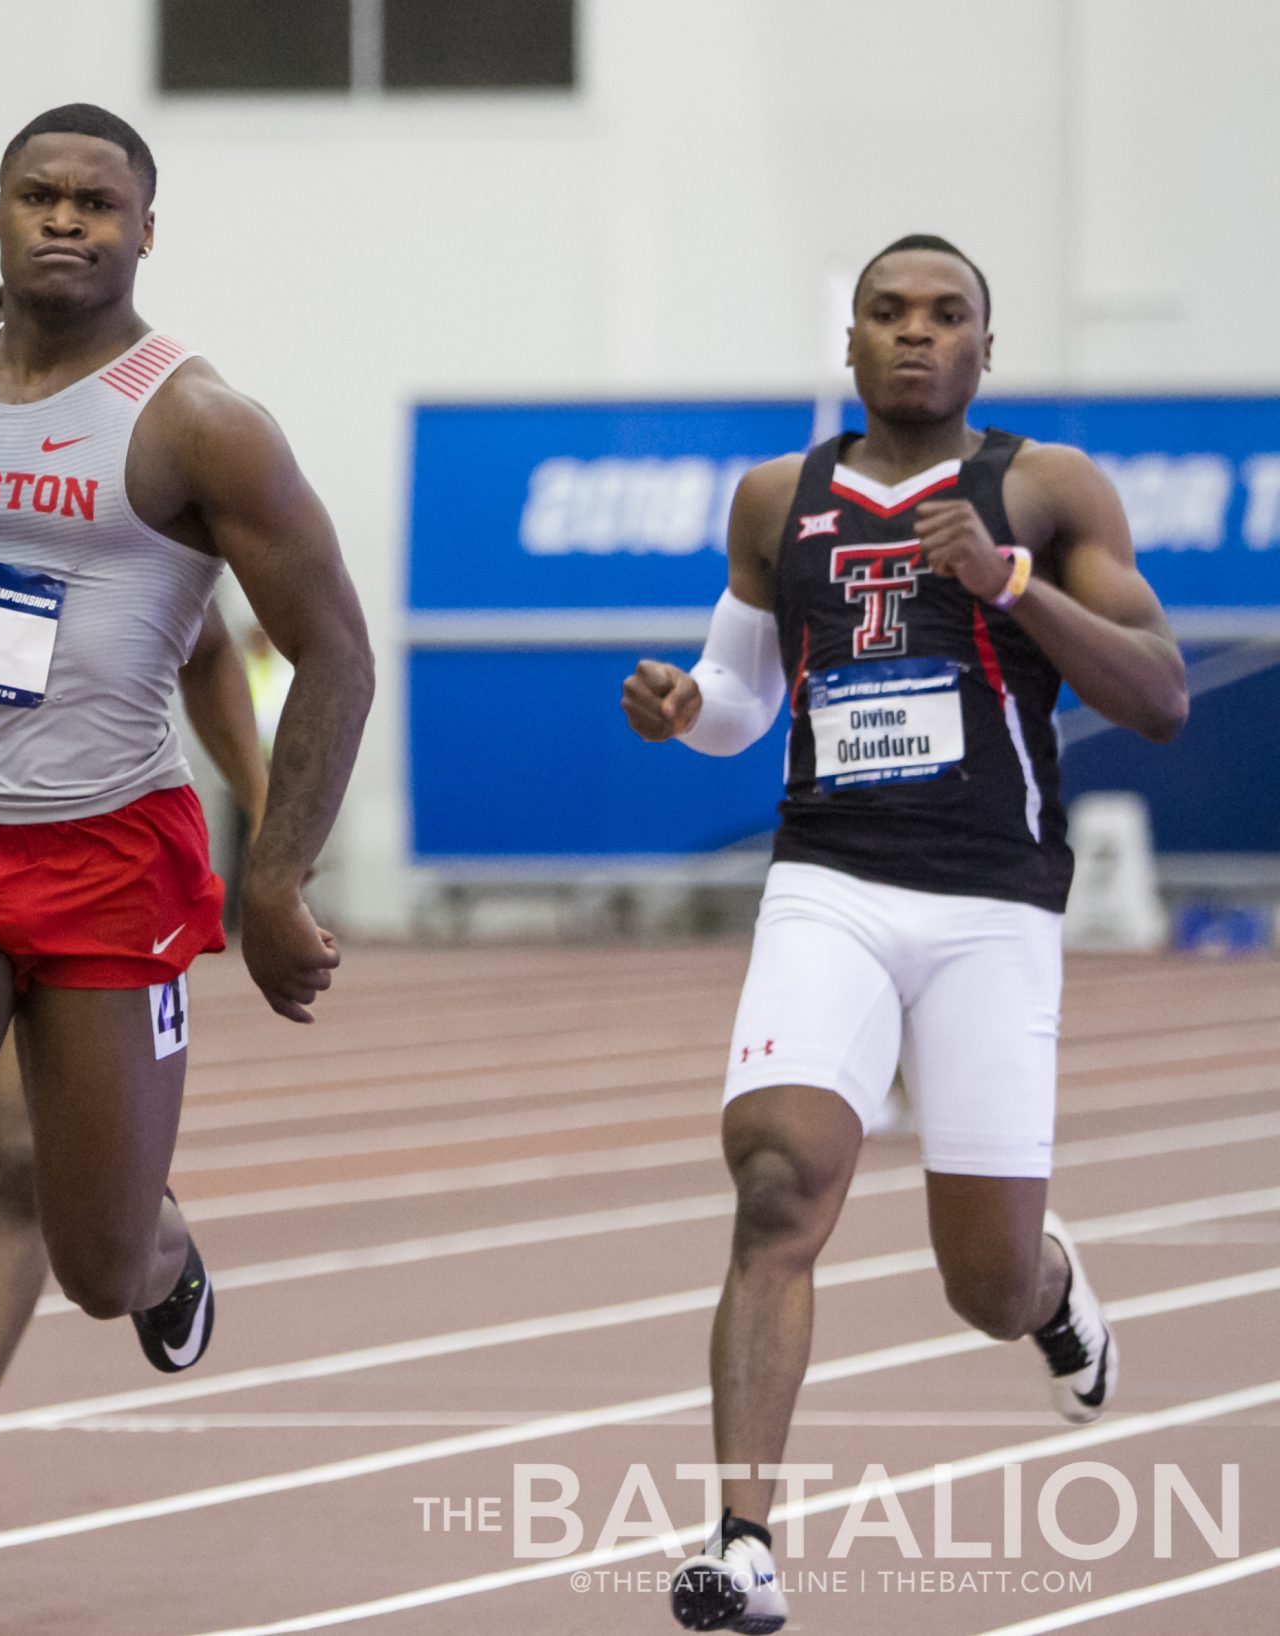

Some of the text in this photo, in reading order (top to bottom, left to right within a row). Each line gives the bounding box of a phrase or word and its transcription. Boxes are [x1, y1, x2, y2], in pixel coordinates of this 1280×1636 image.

[850, 709, 907, 730] Divine
[838, 735, 931, 764] Oduduru
[158, 980, 184, 1043] 4
